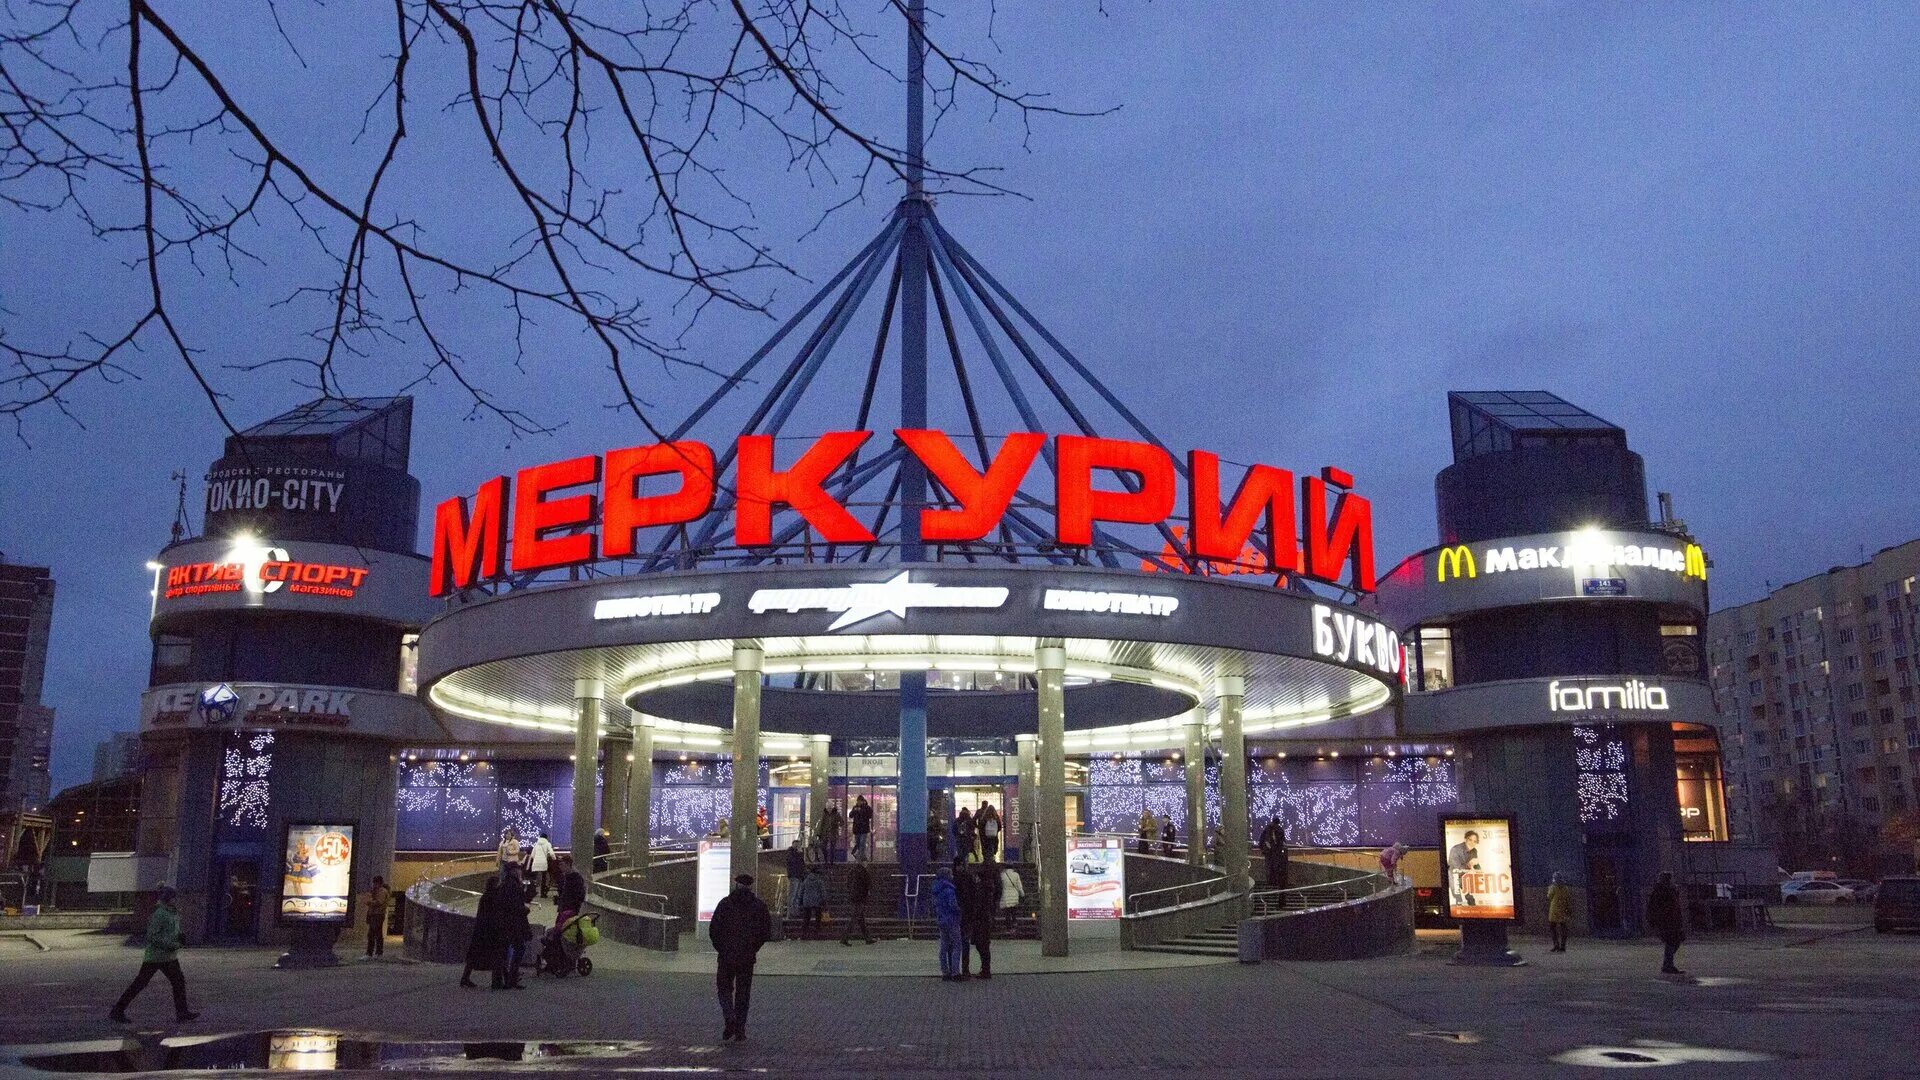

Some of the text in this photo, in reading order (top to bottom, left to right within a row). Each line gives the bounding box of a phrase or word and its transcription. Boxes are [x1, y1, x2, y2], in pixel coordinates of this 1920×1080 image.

[267, 466, 345, 479] РЕСТОРАНЫ
[206, 478, 345, 513] ТОКИО-CITY
[429, 428, 1376, 597] МЕРКУРИЙ
[1486, 545, 1685, 573] Макналдс
[168, 561, 368, 587] АКТИВ СПОРТ
[185, 583, 241, 595] спортивных
[290, 584, 353, 597] магазинов
[1312, 604, 1404, 675] БУКВО
[247, 688, 355, 715] PARK
[1550, 680, 1669, 711] familia
[1011, 797, 1020, 835] НОВЫЙ
[1462, 873, 1510, 894] ЛЕПС
